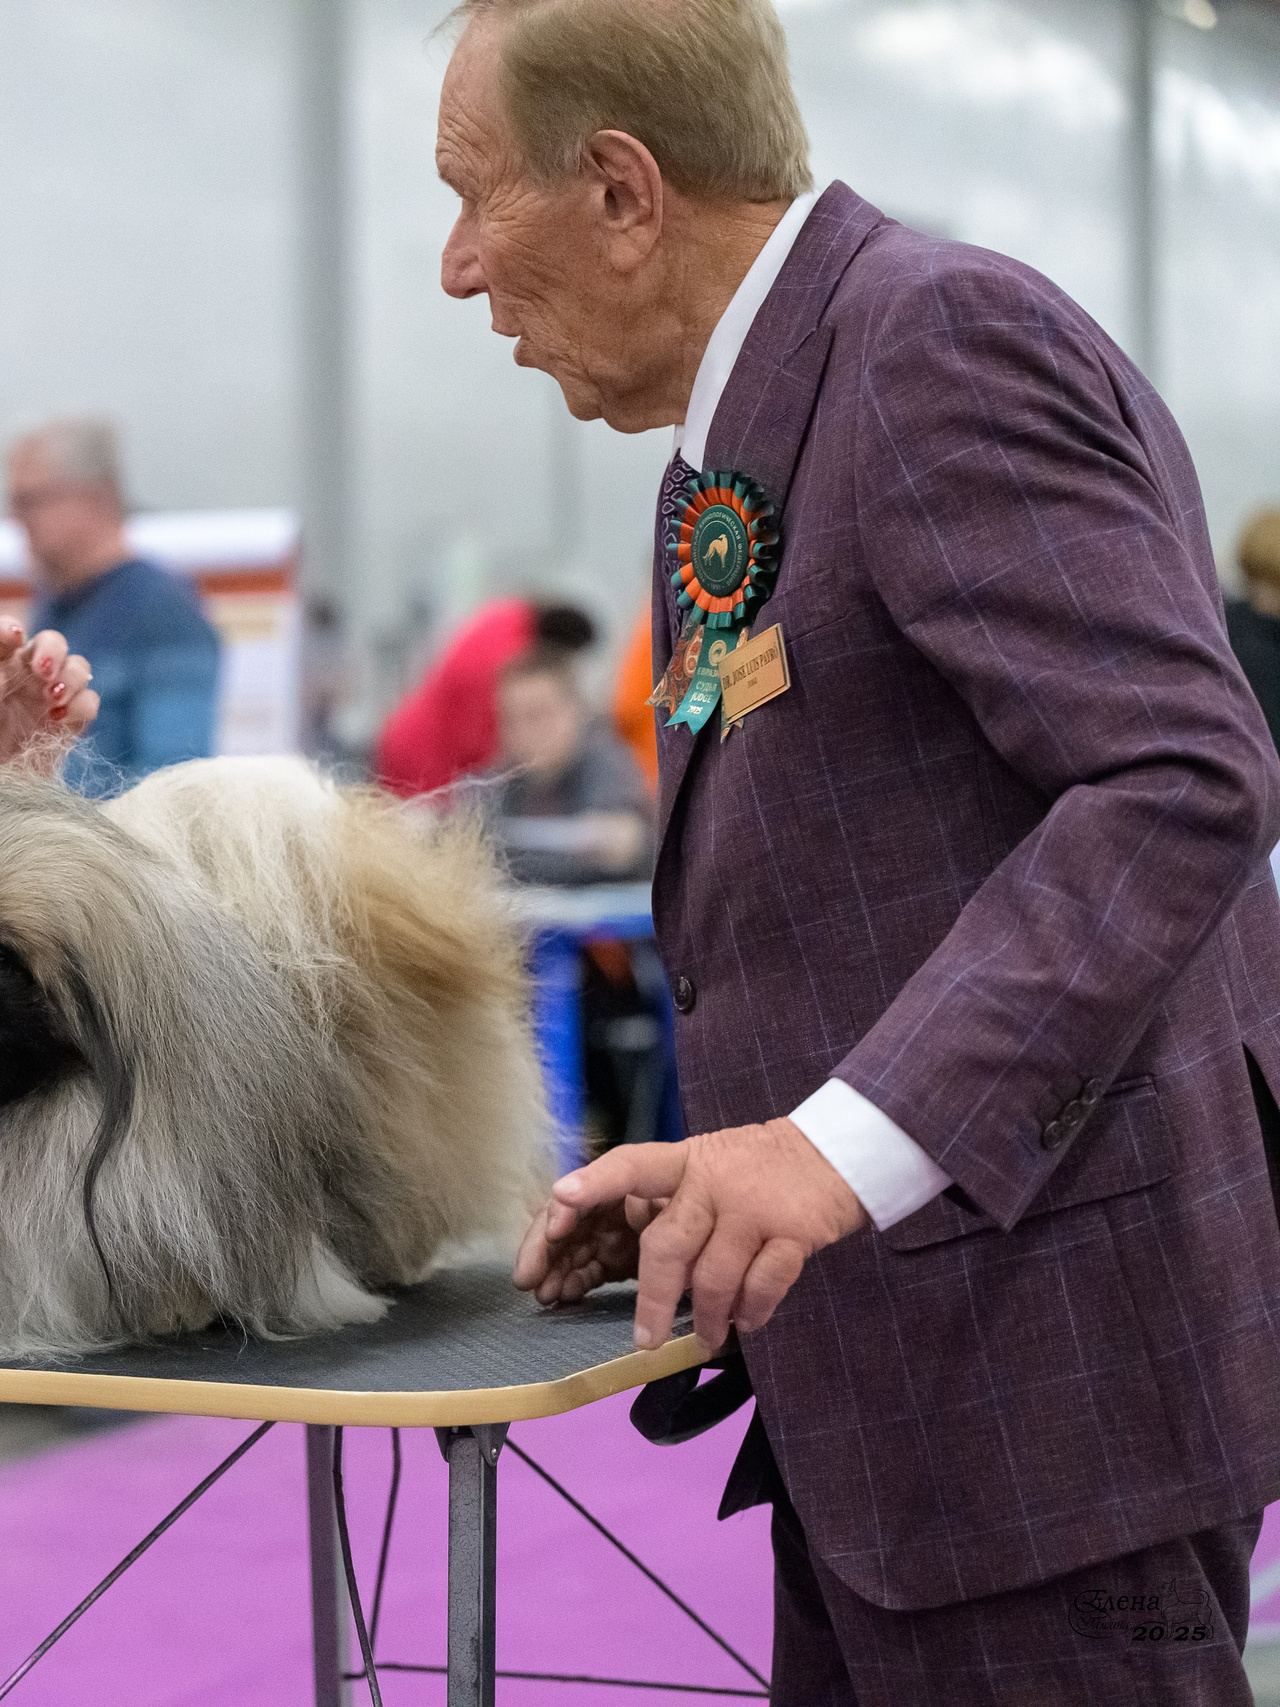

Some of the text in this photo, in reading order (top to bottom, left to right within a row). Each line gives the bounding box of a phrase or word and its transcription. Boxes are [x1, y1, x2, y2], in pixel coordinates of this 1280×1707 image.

[722, 675, 732, 690] DR.
[746, 657, 759, 675] LUIS
[696, 681, 718, 692] СУДЬЯ
[689, 692, 714, 704] JUDGE
